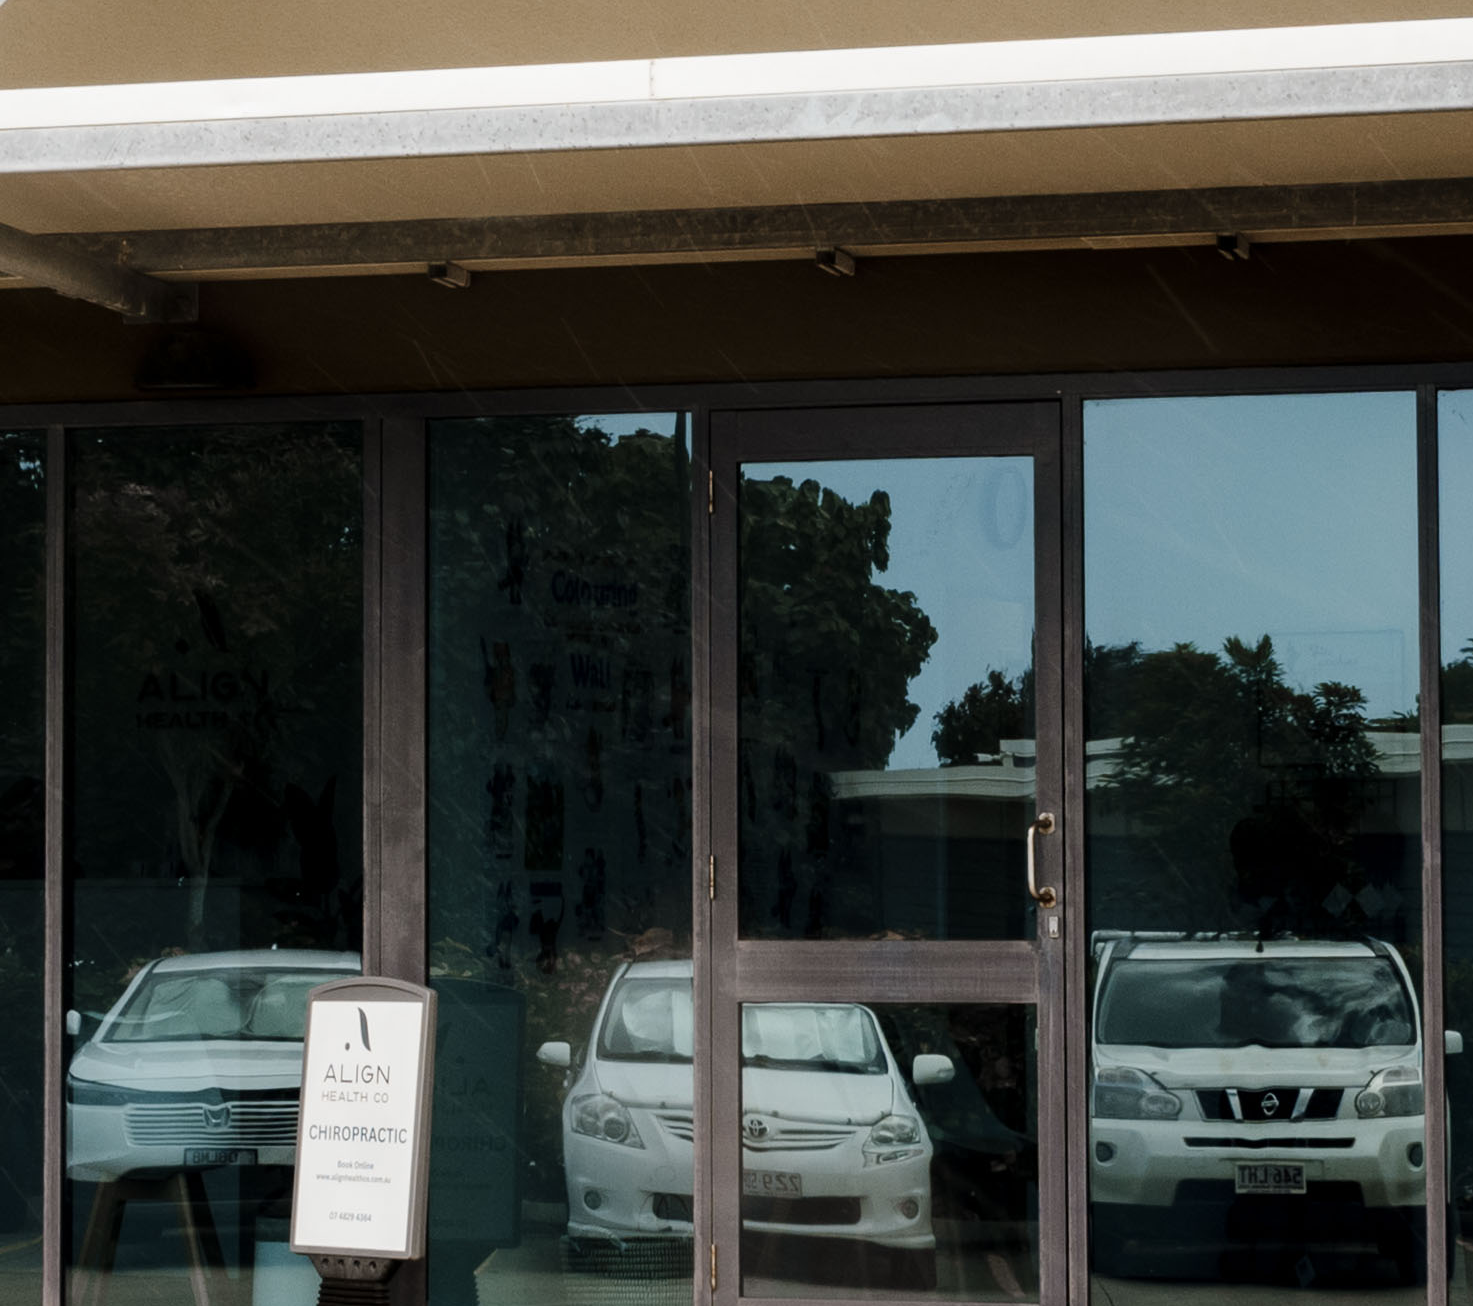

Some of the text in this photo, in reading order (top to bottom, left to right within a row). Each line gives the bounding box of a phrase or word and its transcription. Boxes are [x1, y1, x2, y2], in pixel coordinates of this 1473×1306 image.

[138, 669, 268, 702] ALIGN
[324, 1064, 391, 1084] ALIGN
[322, 1090, 389, 1103] HEALTH CO
[309, 1124, 408, 1144] CHIROPRACTIC
[337, 1160, 374, 1170] Book Online
